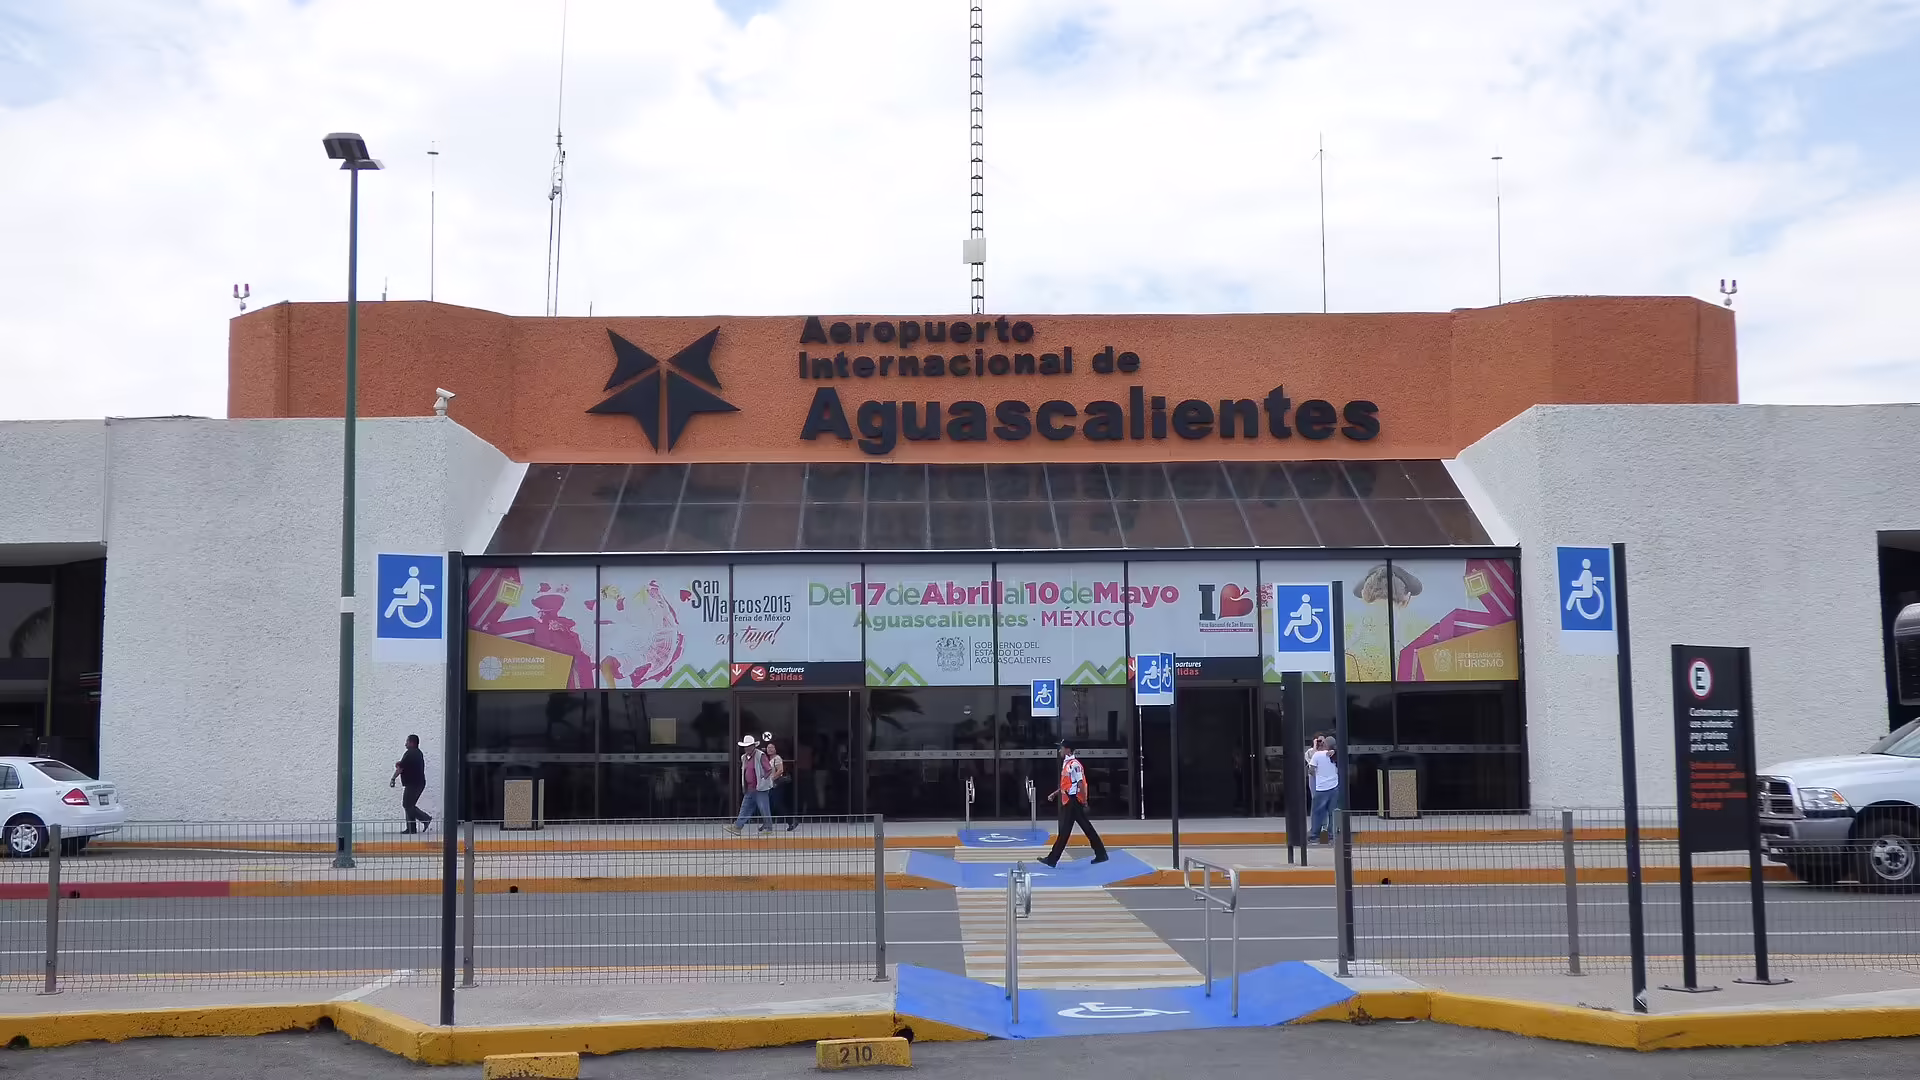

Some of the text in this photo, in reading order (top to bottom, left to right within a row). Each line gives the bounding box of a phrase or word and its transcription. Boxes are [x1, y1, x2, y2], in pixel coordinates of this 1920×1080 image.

[800, 316, 1034, 348] Aeropuerto
[799, 346, 1140, 379] Internacional de
[800, 384, 1381, 455] Aguascalientes
[691, 579, 720, 609] San
[763, 595, 791, 613] 2015
[734, 614, 752, 622] Feria
[753, 614, 763, 622] de
[764, 612, 791, 622] México
[853, 606, 1135, 632] Aguascalientes MÉXICO
[740, 621, 784, 650] tuya!
[1024, 641, 1040, 649] DEL
[1013, 649, 1025, 657] DE
[769, 666, 805, 674] Departures
[1457, 658, 1504, 668] TURISMO
[769, 673, 803, 681] Salidas
[1695, 667, 1706, 690] E
[839, 1045, 873, 1064] 210
